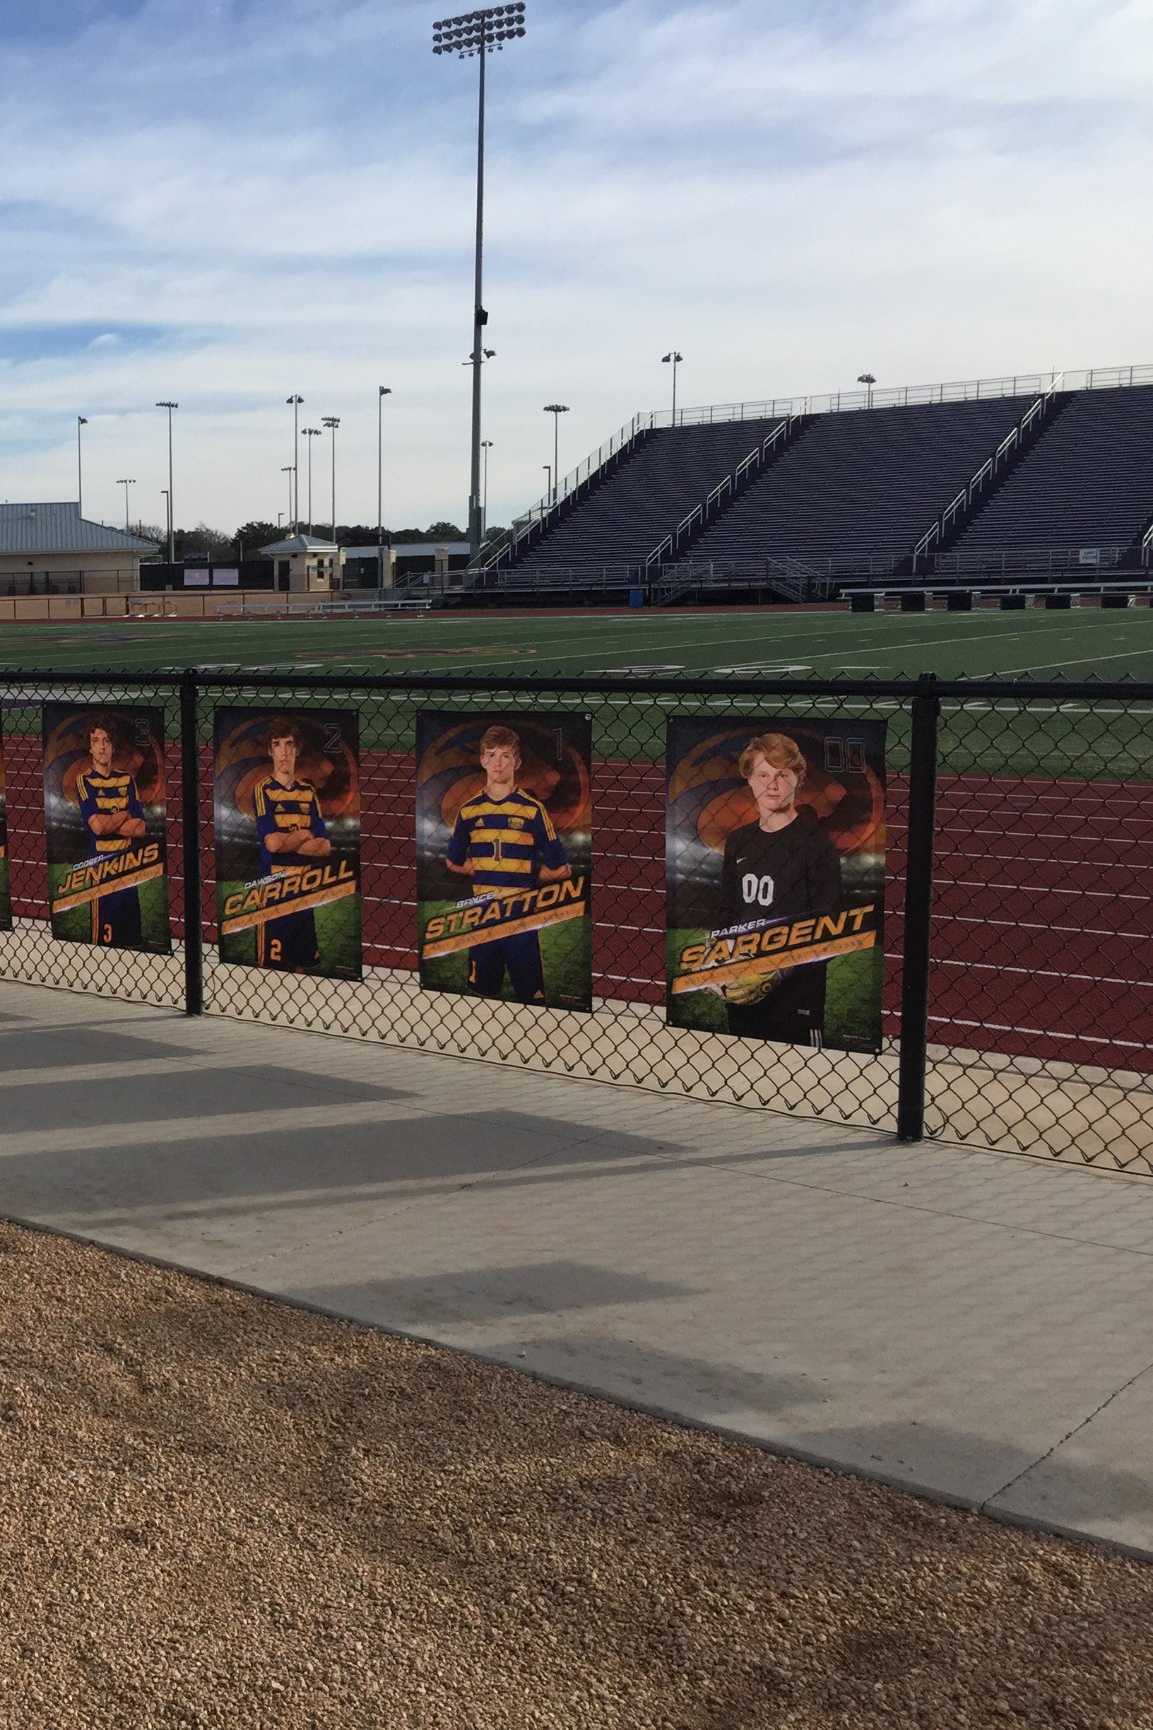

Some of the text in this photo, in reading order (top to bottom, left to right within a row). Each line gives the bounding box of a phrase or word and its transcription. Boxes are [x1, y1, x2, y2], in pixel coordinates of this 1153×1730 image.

[323, 722, 343, 754] 2
[552, 727, 563, 761] 1
[824, 736, 865, 774] 00
[493, 839, 502, 861] 1
[57, 843, 159, 894] JENKINS
[244, 871, 287, 890] DAWSON
[224, 859, 355, 915] CARROLL
[455, 891, 495, 909] BRYCE
[741, 873, 774, 906] 00
[424, 876, 585, 939] STRATTON
[103, 923, 112, 943] 3
[679, 904, 875, 971] SARGENT
[710, 918, 767, 939] PARKER
[270, 938, 282, 961] 2
[468, 959, 477, 984] 1
